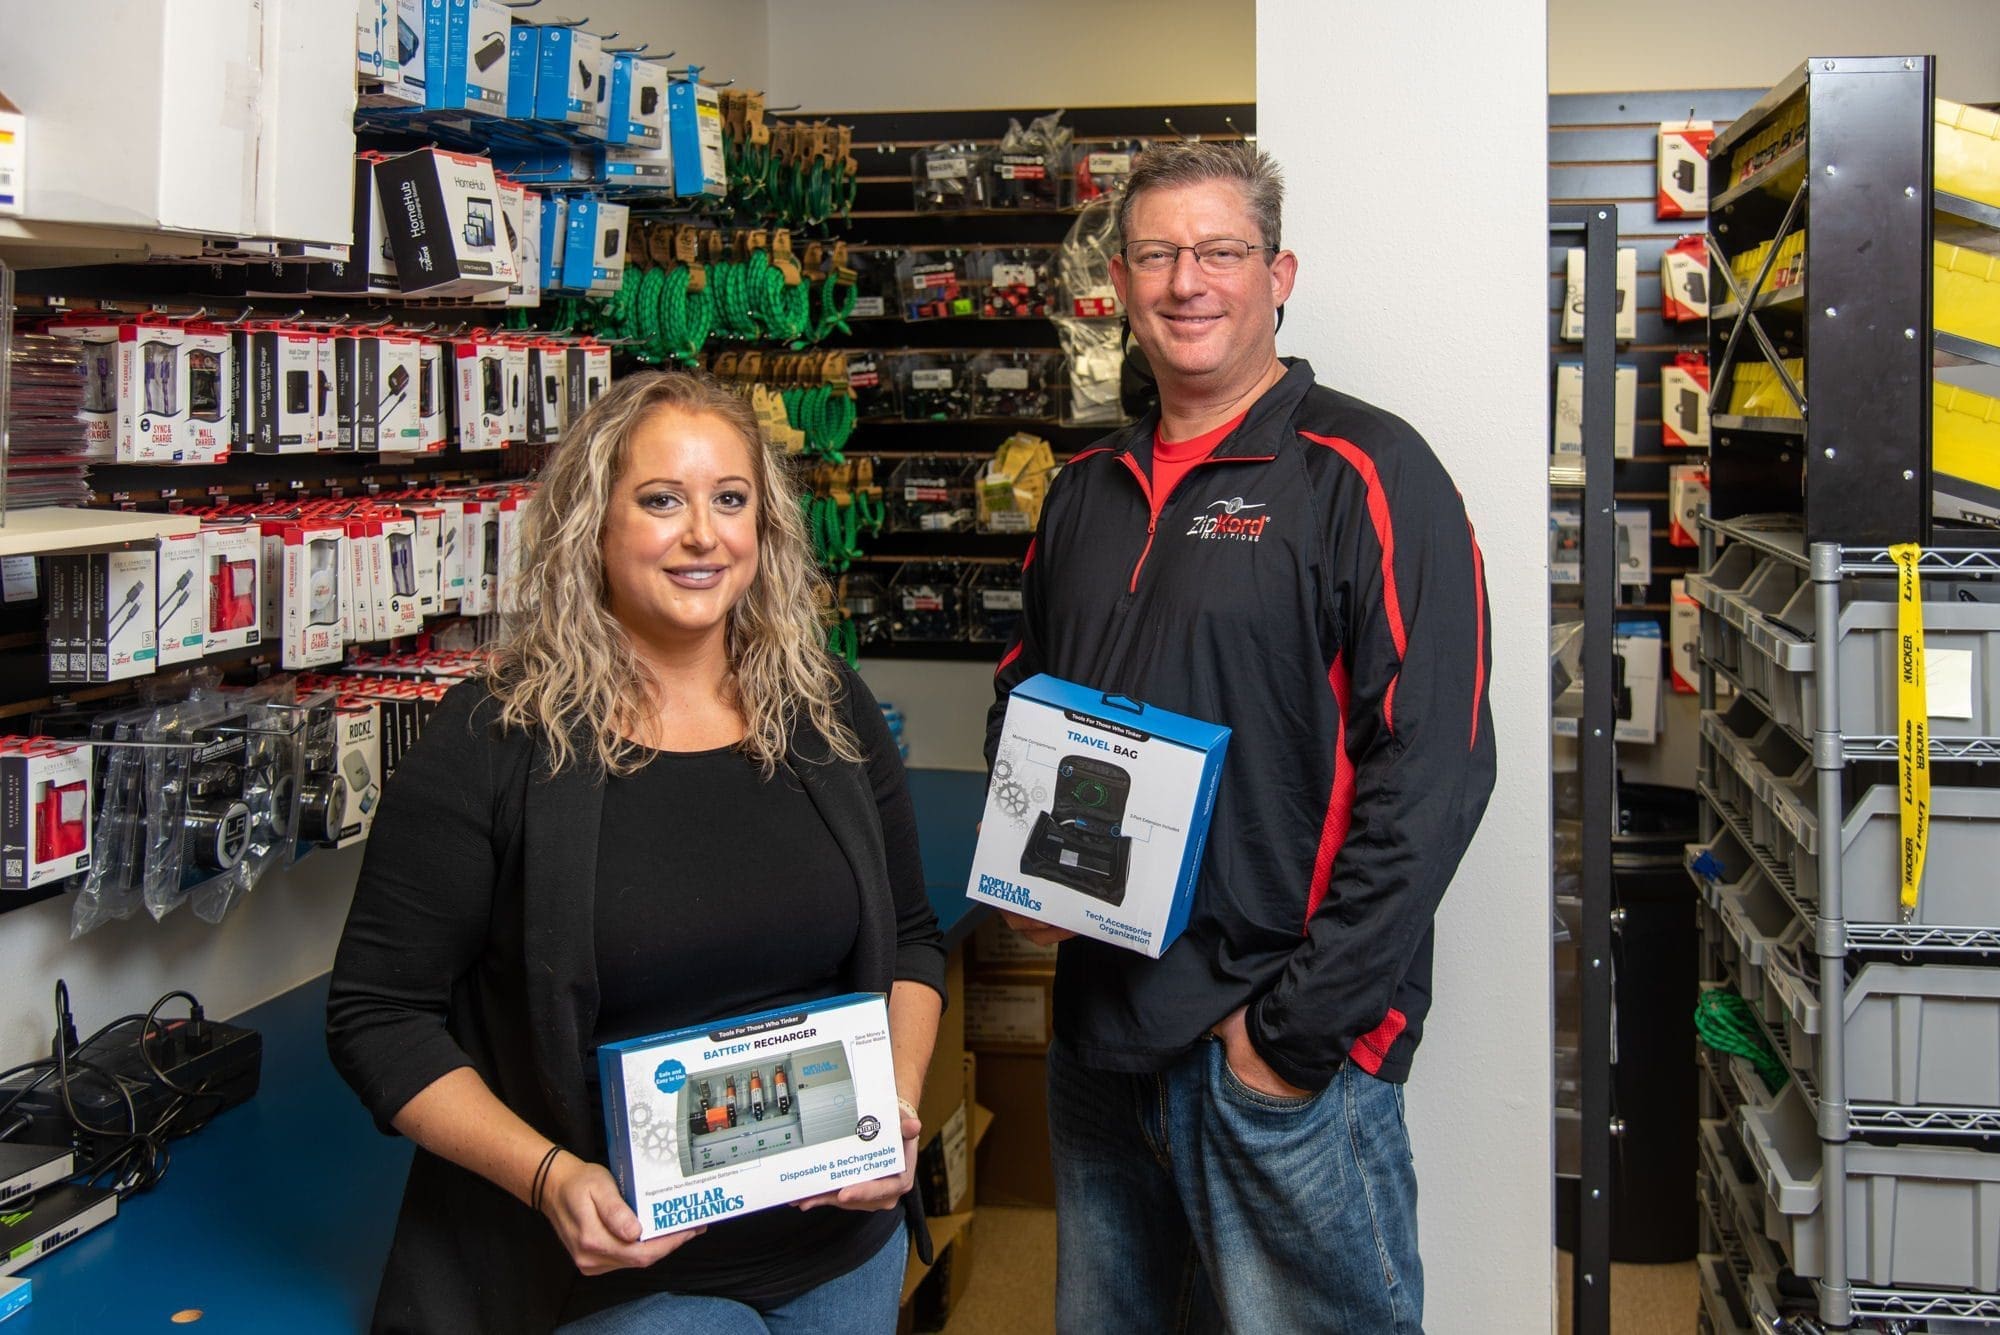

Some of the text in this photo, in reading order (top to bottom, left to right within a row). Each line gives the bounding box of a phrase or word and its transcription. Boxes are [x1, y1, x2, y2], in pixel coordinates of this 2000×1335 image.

[454, 176, 486, 191] HomeHub
[401, 182, 421, 239] HomeHub
[152, 434, 173, 444] CHARGE
[311, 640, 329, 650] CHARGE
[1903, 635, 1913, 675] KICKER
[349, 720, 371, 739] ROCKZ
[1072, 713, 1086, 722] Tools
[1095, 720, 1112, 729] Those
[1111, 724, 1125, 733] Who
[1125, 728, 1142, 738] Tinker
[1067, 730, 1138, 760] TRAVEL BAG
[1917, 731, 1925, 770] KICKER
[1905, 837, 1913, 879] KICKER
[978, 883, 1042, 911] MECHANICS
[979, 873, 1031, 898] POPULAR
[1085, 910, 1152, 938] Tech Accessories
[1099, 923, 1150, 945] Organization
[718, 1016, 799, 1038] Tools For Those Who Tinker
[703, 1028, 817, 1060] BATTERY RECHARGER
[658, 1070, 671, 1078] Safe
[856, 1122, 880, 1134] PATENTED
[779, 1146, 896, 1182] Disposable & ReChargeable
[830, 1157, 897, 1180] Battery Charger
[652, 1186, 725, 1217] POPULAR
[654, 1195, 745, 1231] MECHANICS
